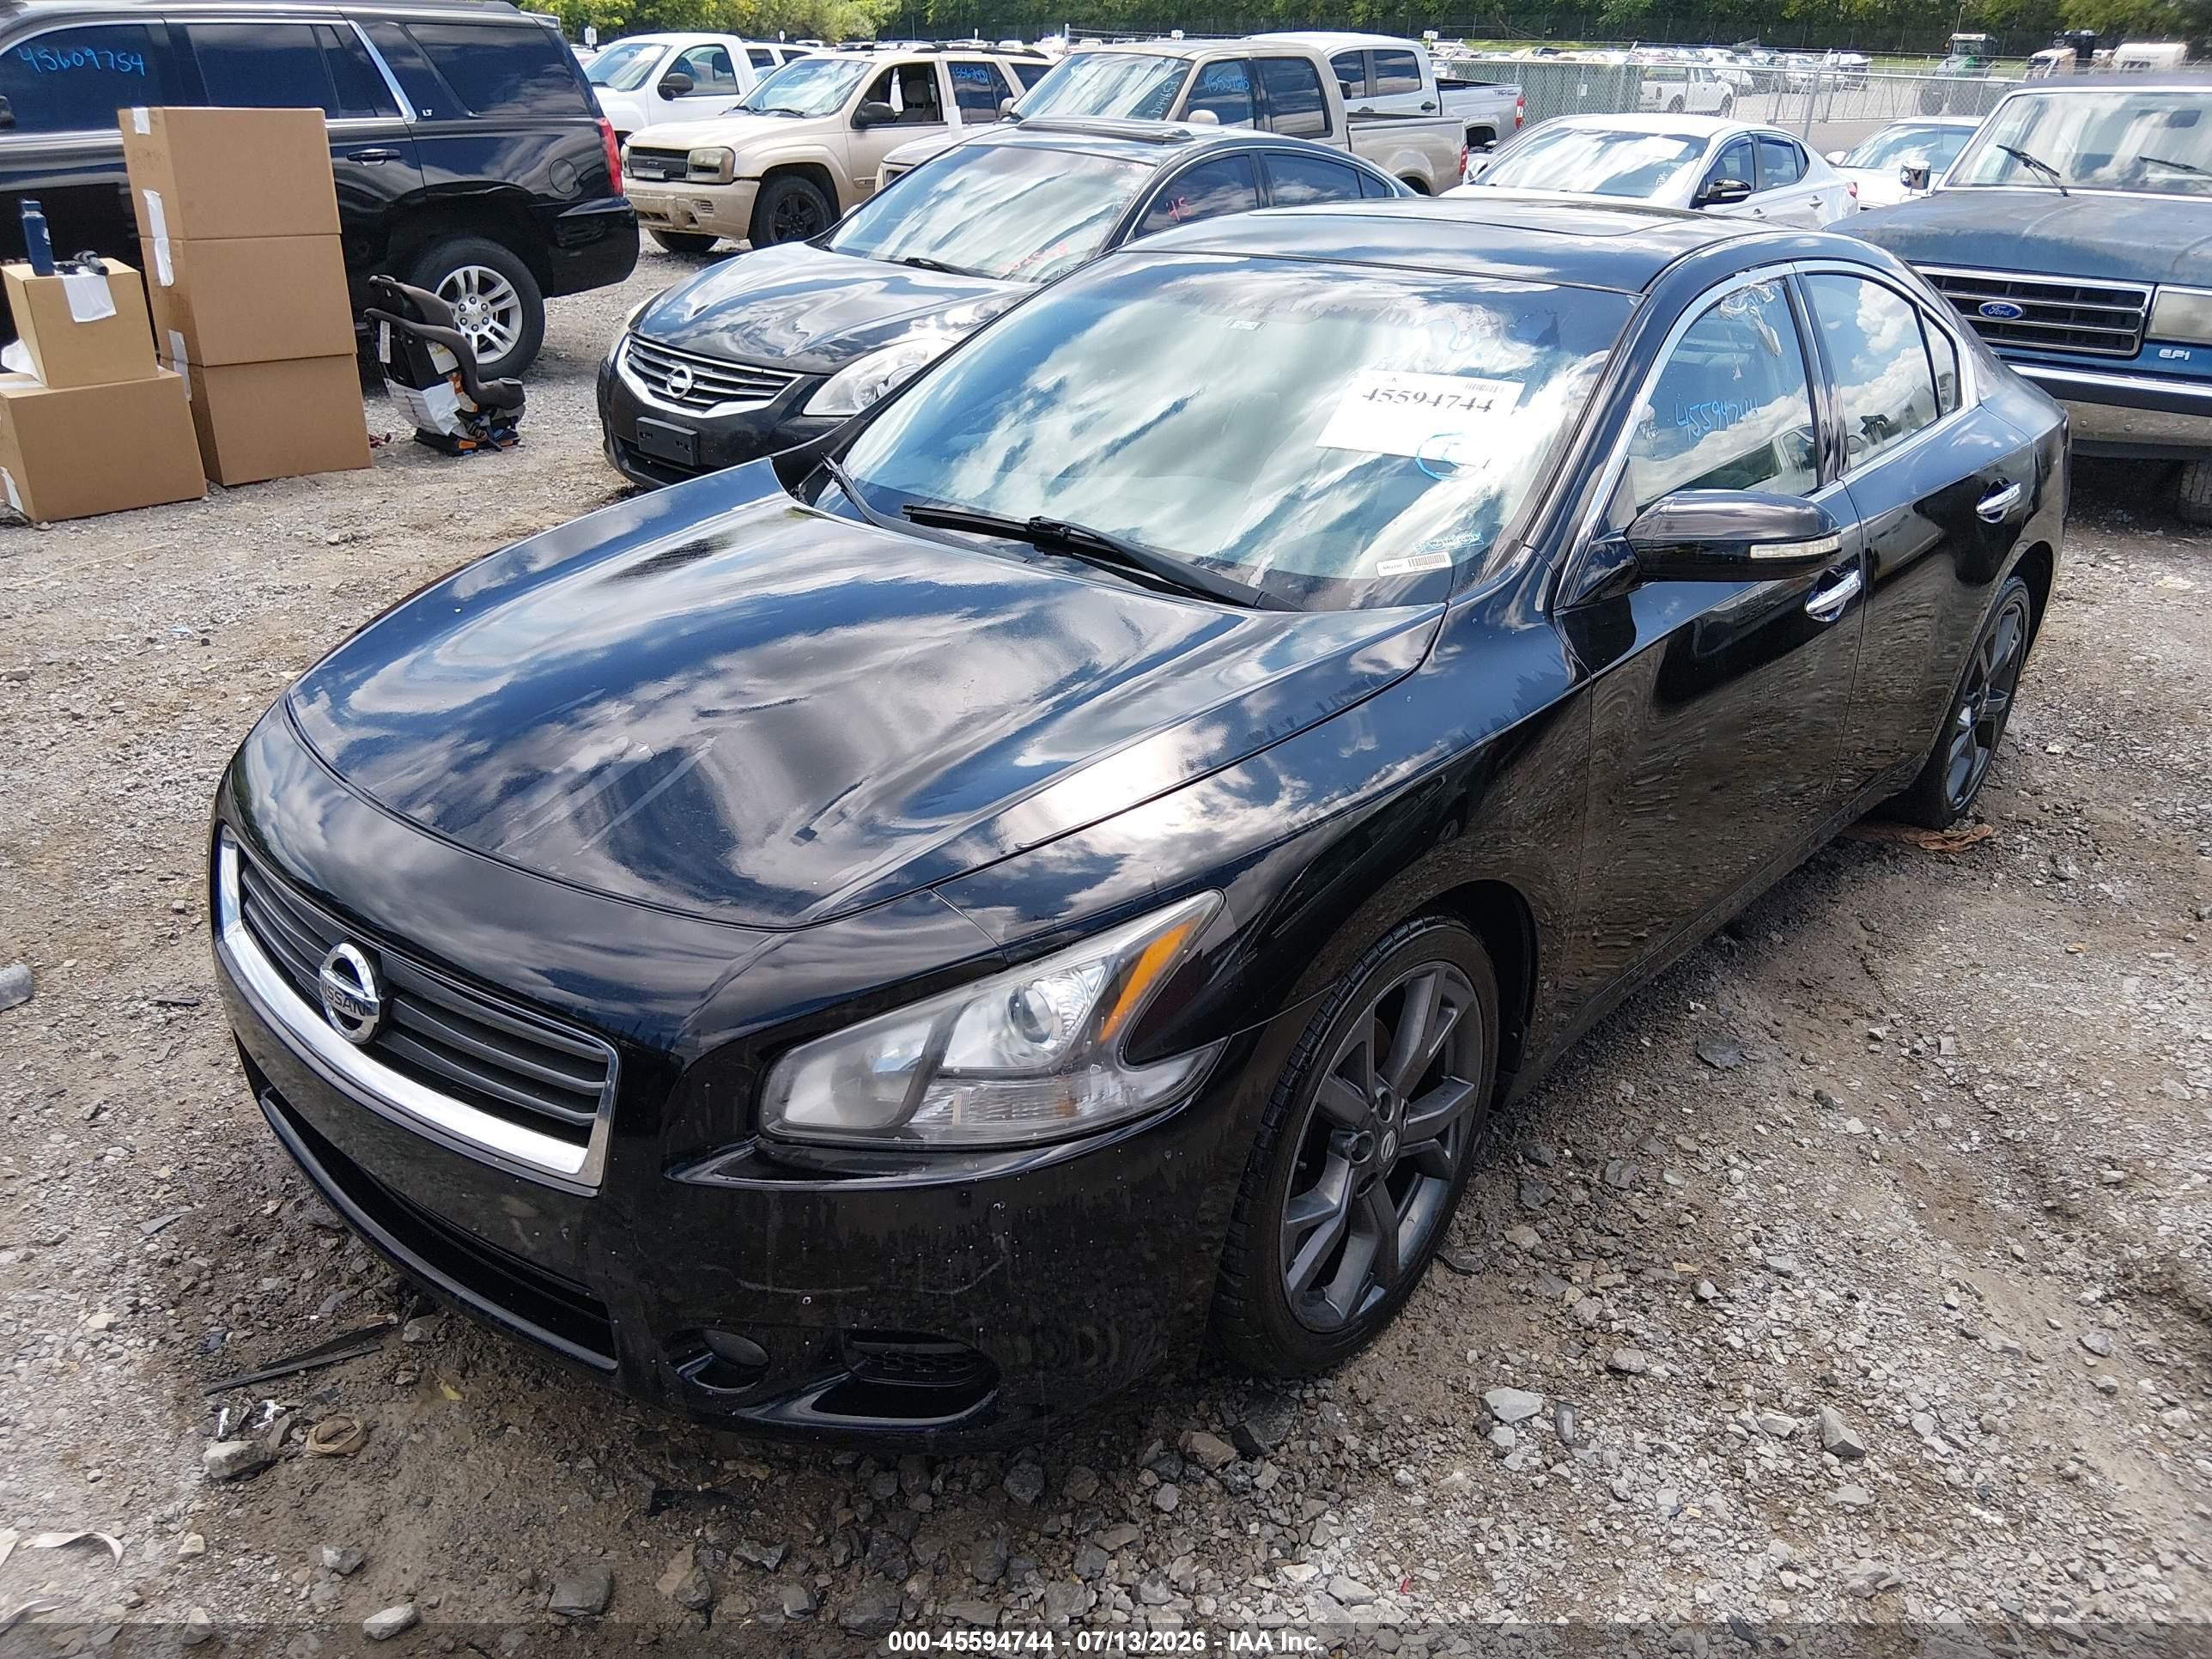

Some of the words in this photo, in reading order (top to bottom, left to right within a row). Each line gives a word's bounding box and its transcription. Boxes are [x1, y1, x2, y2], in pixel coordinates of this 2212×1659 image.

[18, 46, 145, 76] 45609754
[422, 108, 434, 117] LT
[1988, 305, 2012, 316] Ford
[2158, 348, 2191, 361] EFI
[1362, 387, 1494, 413] 45594744
[1675, 398, 1759, 441] 45594744
[321, 981, 367, 1018] NISSAN
